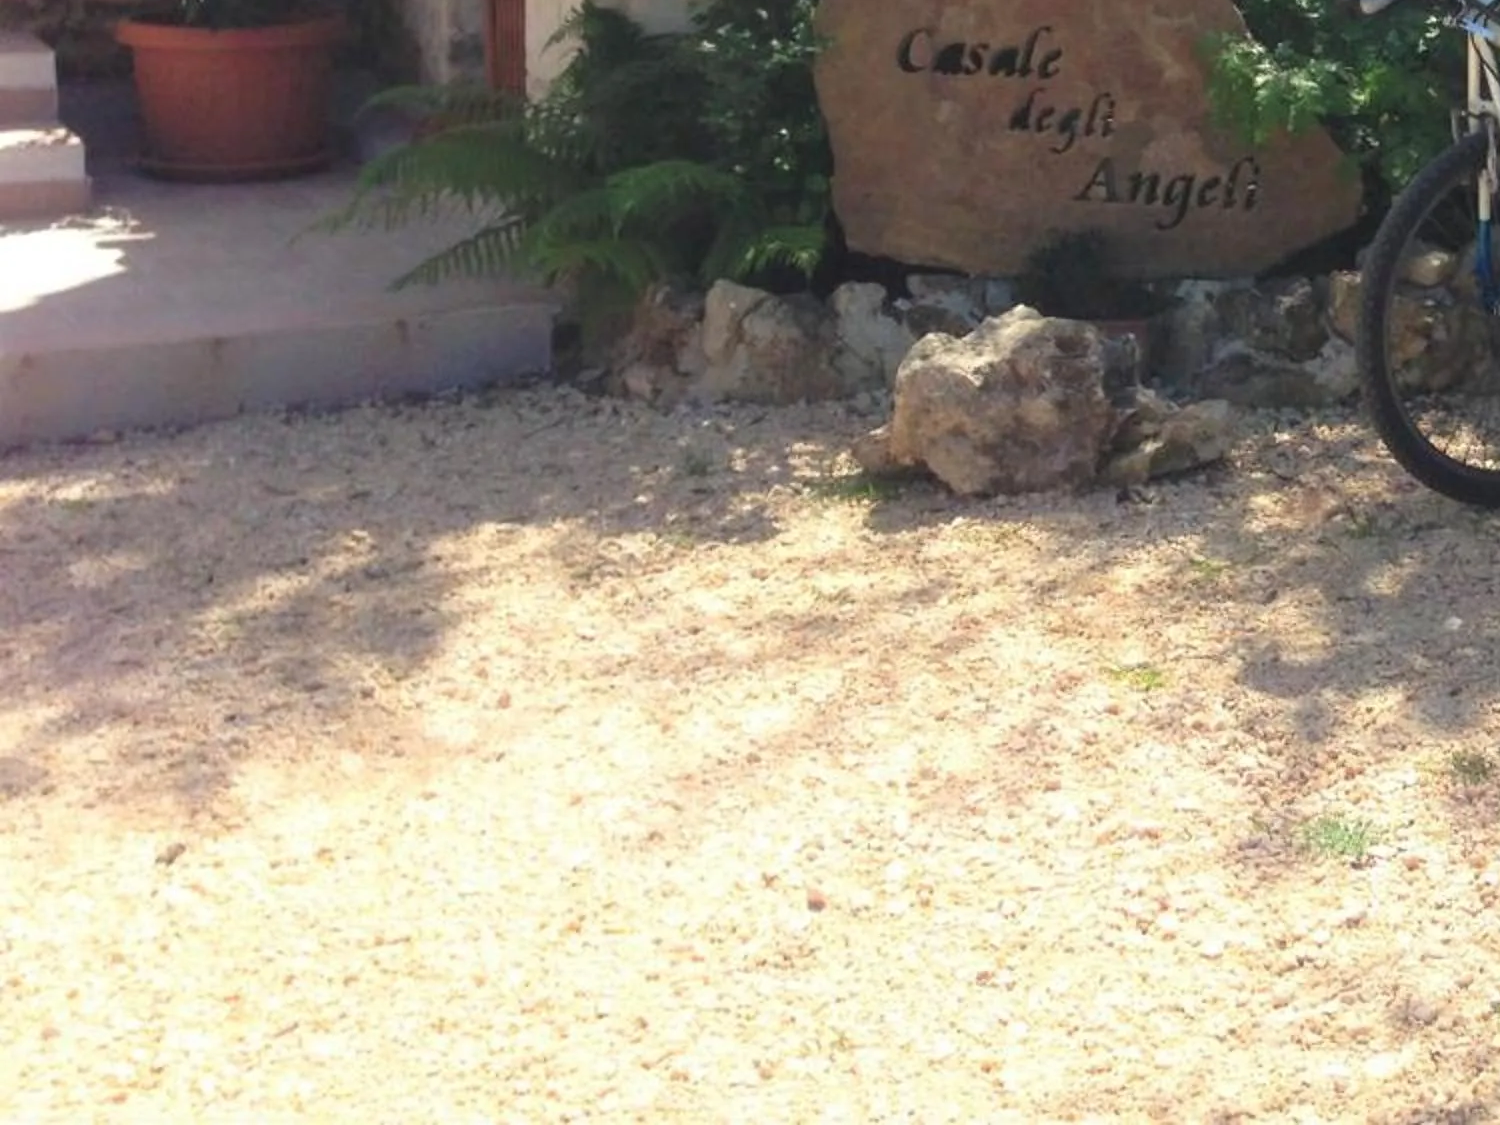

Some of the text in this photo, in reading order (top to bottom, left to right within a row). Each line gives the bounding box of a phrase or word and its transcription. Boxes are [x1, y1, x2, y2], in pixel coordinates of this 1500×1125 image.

[896, 26, 1063, 79] Casale
[1008, 87, 1118, 154] degli
[1070, 156, 1261, 231] Angeli
